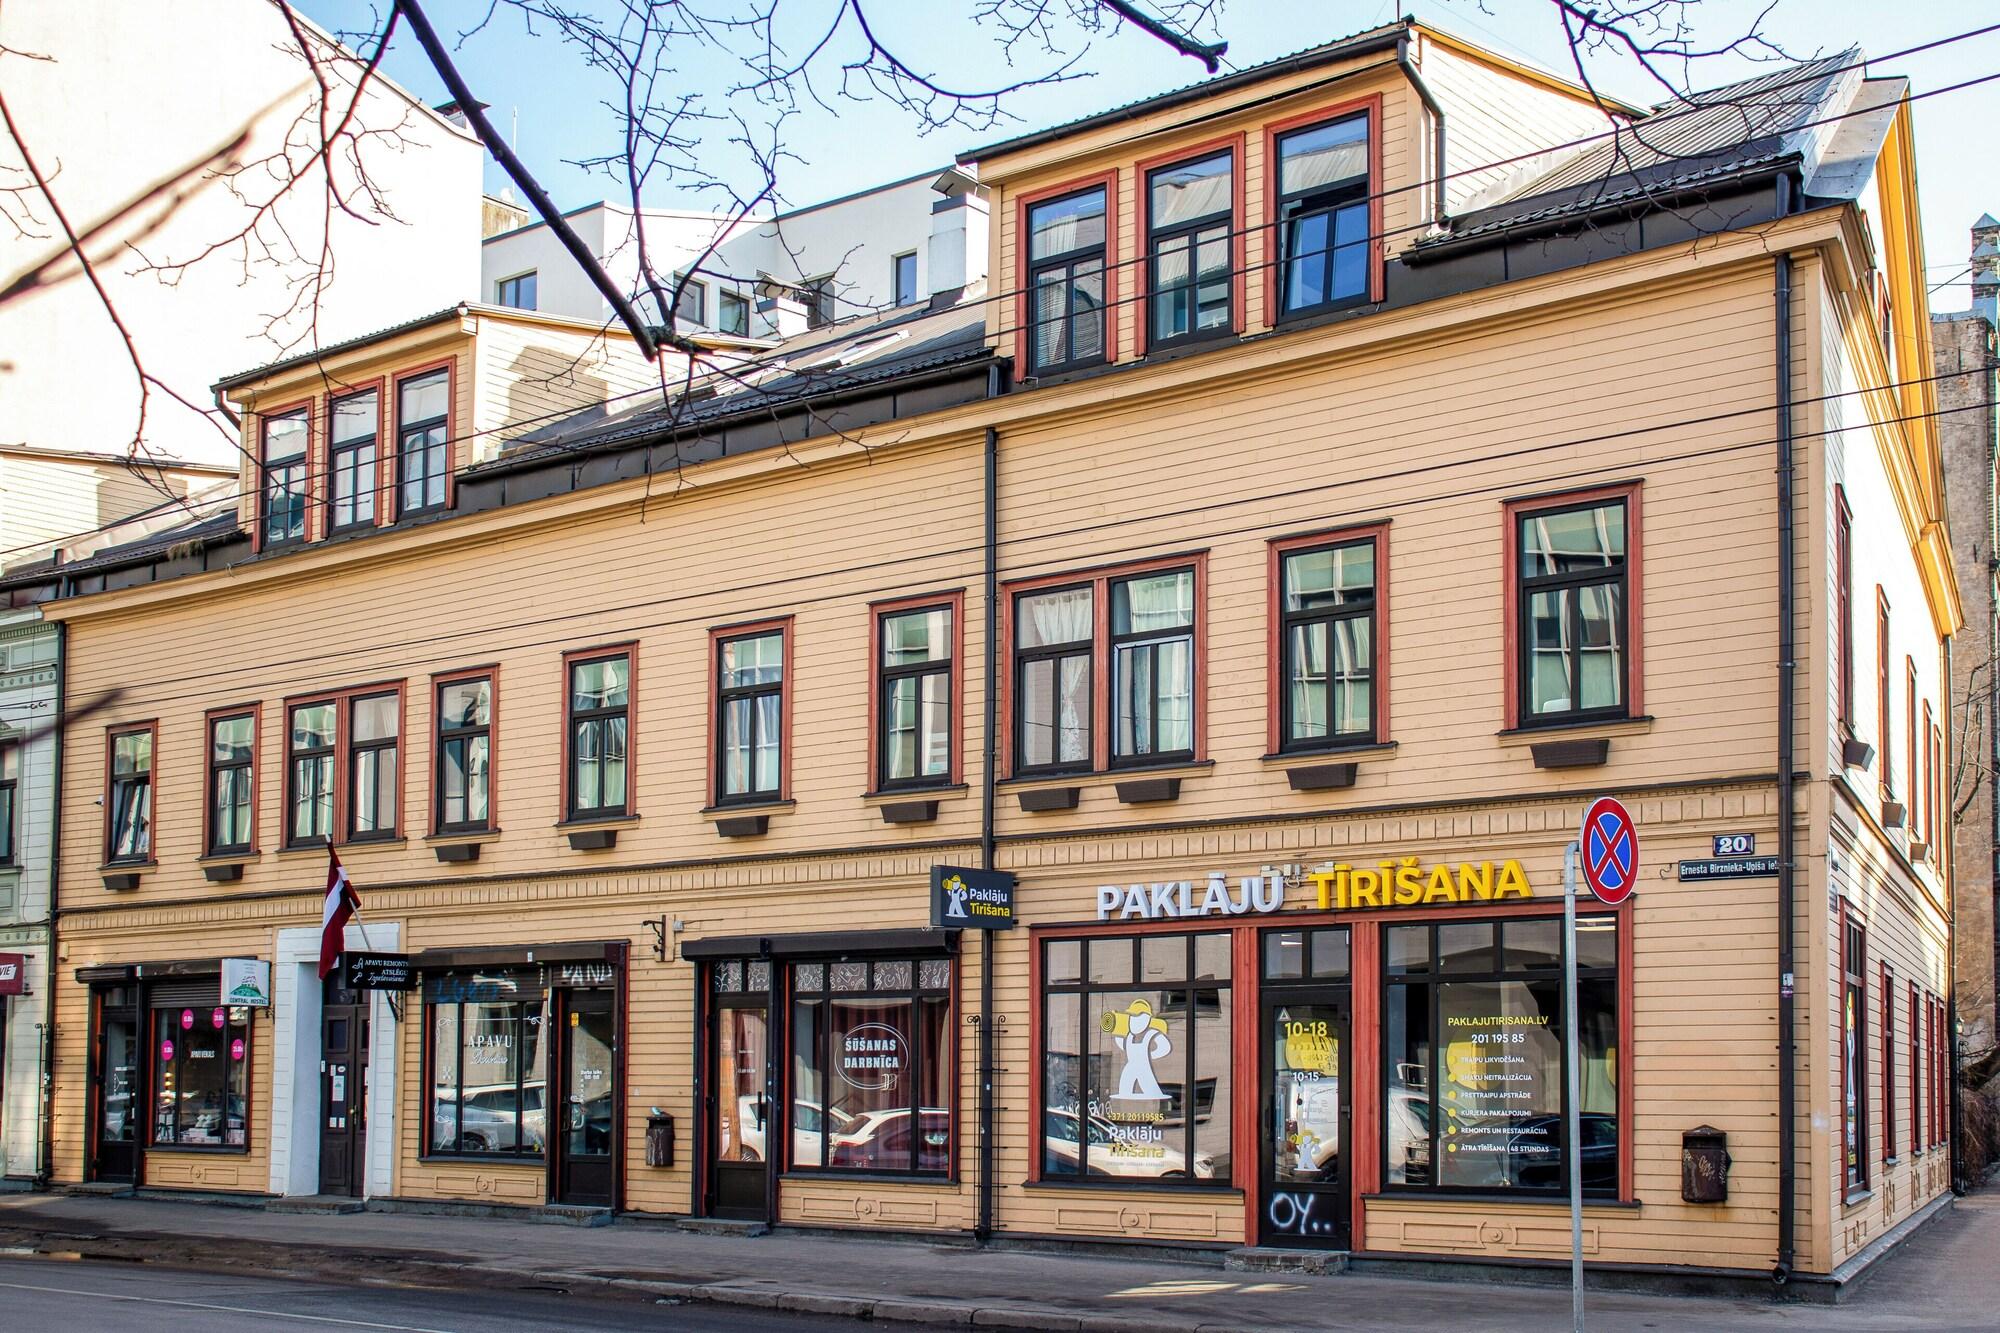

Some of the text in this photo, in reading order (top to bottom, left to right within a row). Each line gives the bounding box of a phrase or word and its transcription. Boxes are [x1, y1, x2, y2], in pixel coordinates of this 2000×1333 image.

[1719, 836, 1748, 853] 20
[1681, 864, 1708, 875] Ernesta
[1097, 855, 1534, 920] PAKLĀJU TĪRĪŠANA
[969, 888, 1008, 905] Paklāju
[970, 902, 1010, 917] Tīrīšana
[1447, 1016, 1549, 1026] PAKLAJUTIRISANA.LV
[1284, 1021, 1328, 1037] 10-18
[468, 1035, 513, 1048] APAVU
[845, 1037, 897, 1052] ŠŪŠANAS
[1471, 1033, 1525, 1044] 201 195 85
[844, 1055, 900, 1069] DARBNĪCA
[1292, 1071, 1320, 1082] 10-15
[1499, 1091, 1532, 1099] APSTRĀDE
[1107, 1113, 1164, 1121] +371 20119585
[1108, 1125, 1162, 1143] Paklāju
[1502, 1127, 1548, 1135] RESTAURĀCIJA
[1461, 1143, 1478, 1152] ĀTRA
